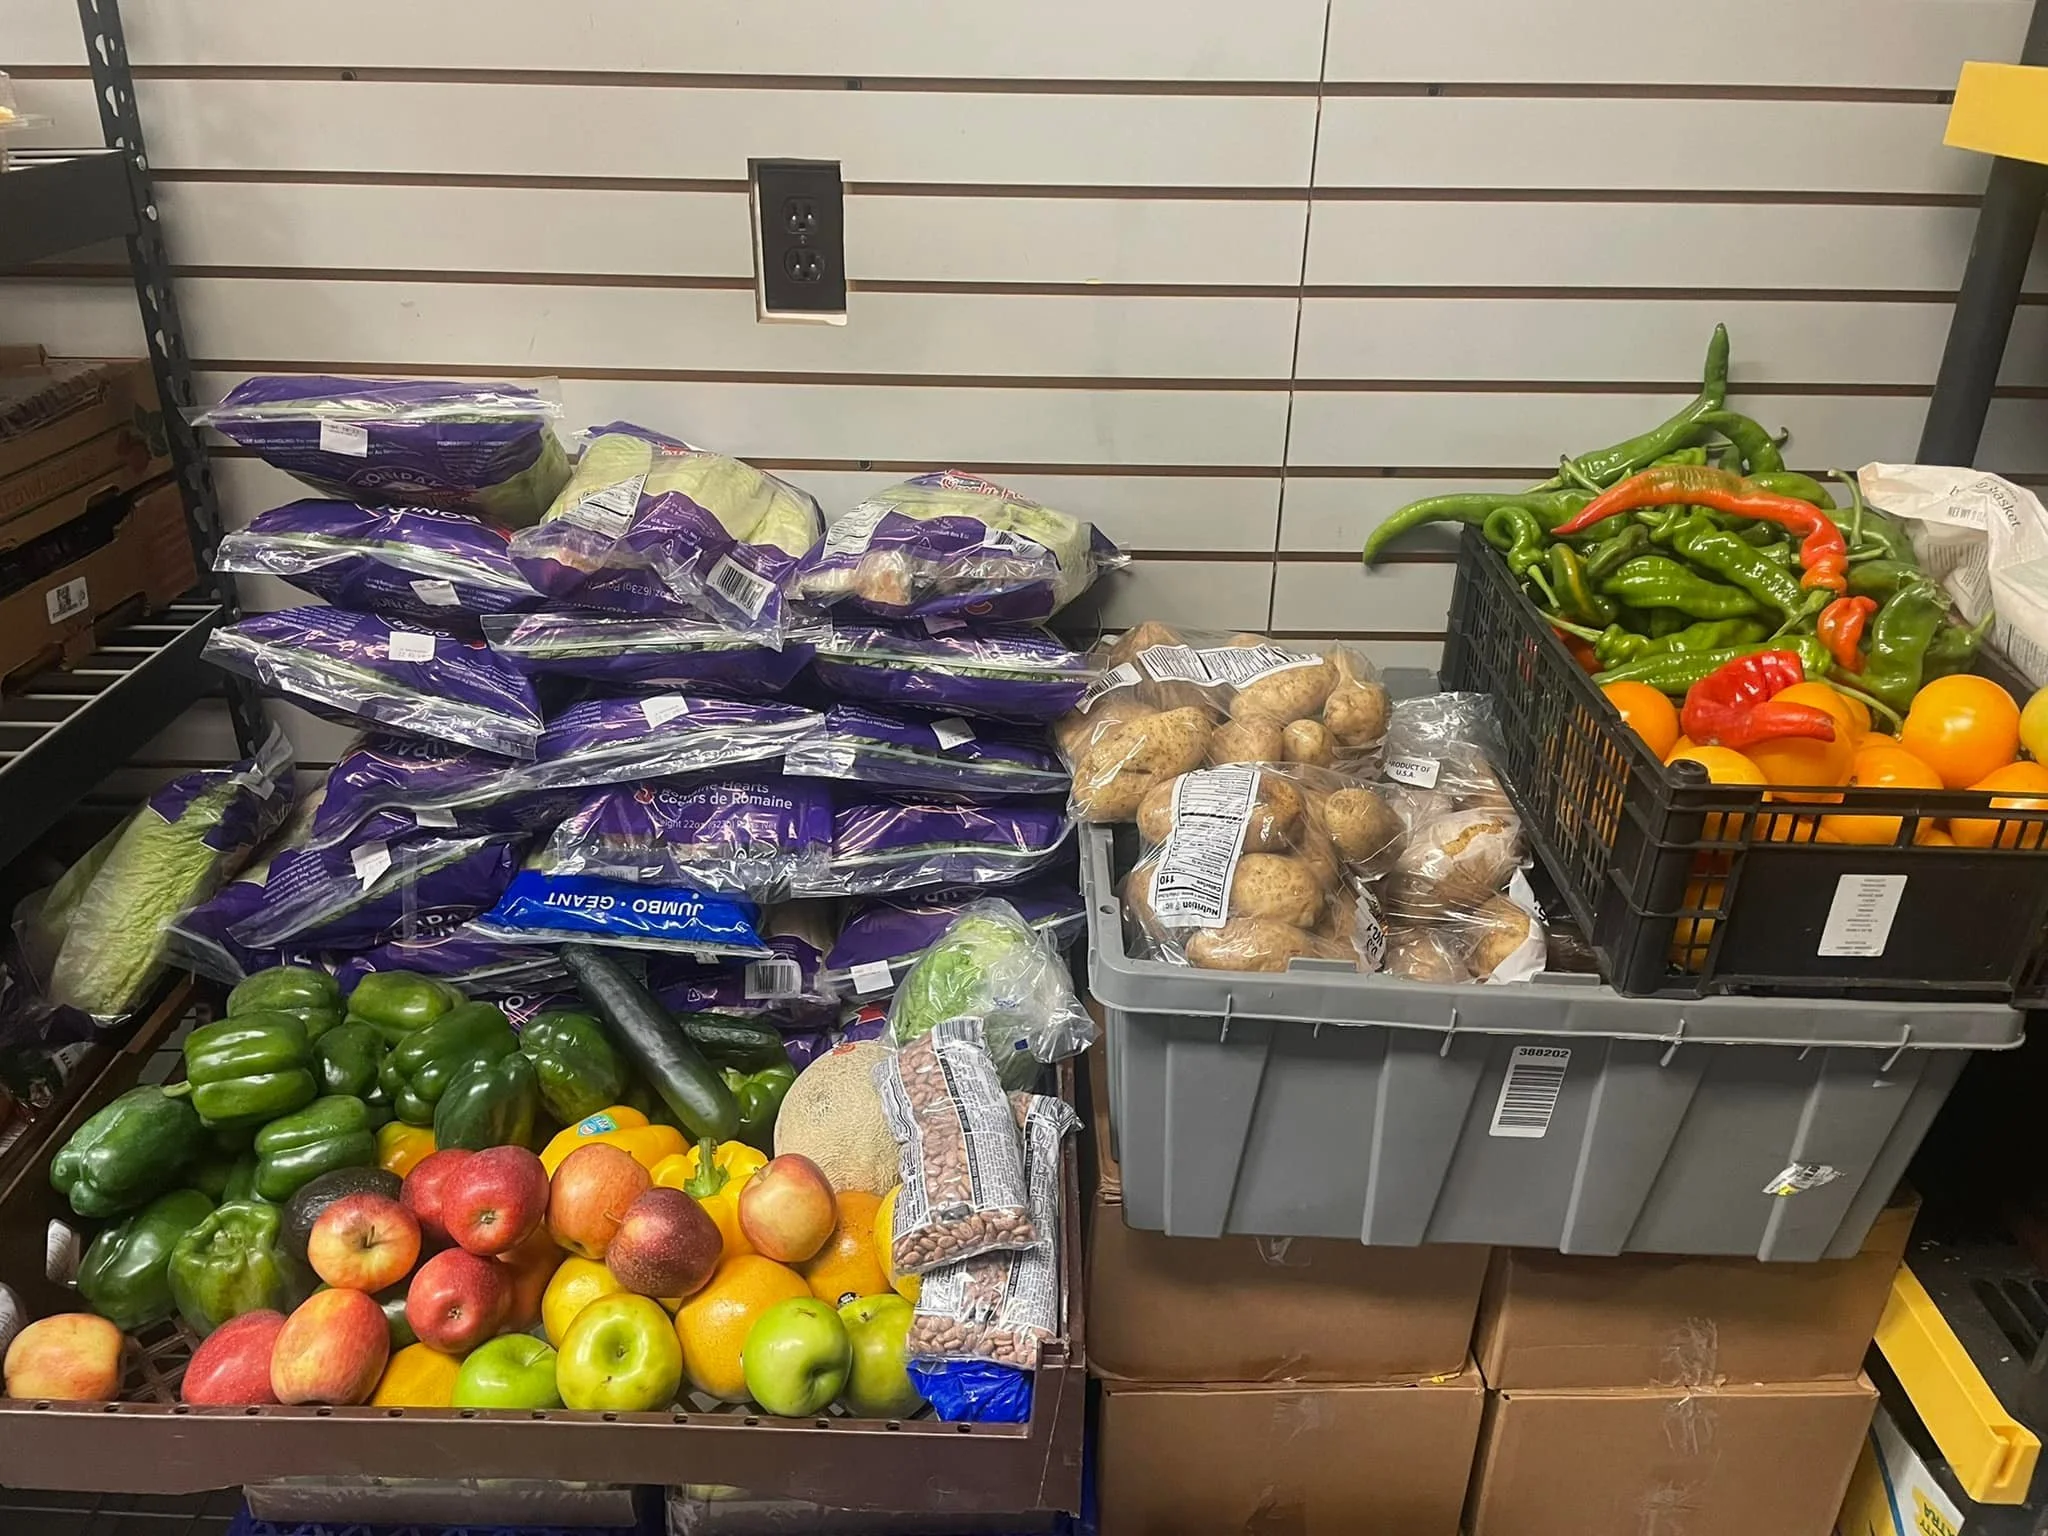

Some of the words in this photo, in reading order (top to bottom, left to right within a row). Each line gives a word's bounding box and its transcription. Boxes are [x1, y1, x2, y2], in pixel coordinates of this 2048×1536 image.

[709, 792, 728, 806] de
[731, 792, 793, 810] Romaine
[1159, 874, 1176, 886] 110
[543, 892, 615, 914] GÉANT
[632, 899, 704, 917] JUMBO
[1182, 900, 1219, 916] Nutrition
[1518, 1047, 1570, 1059] 388202
